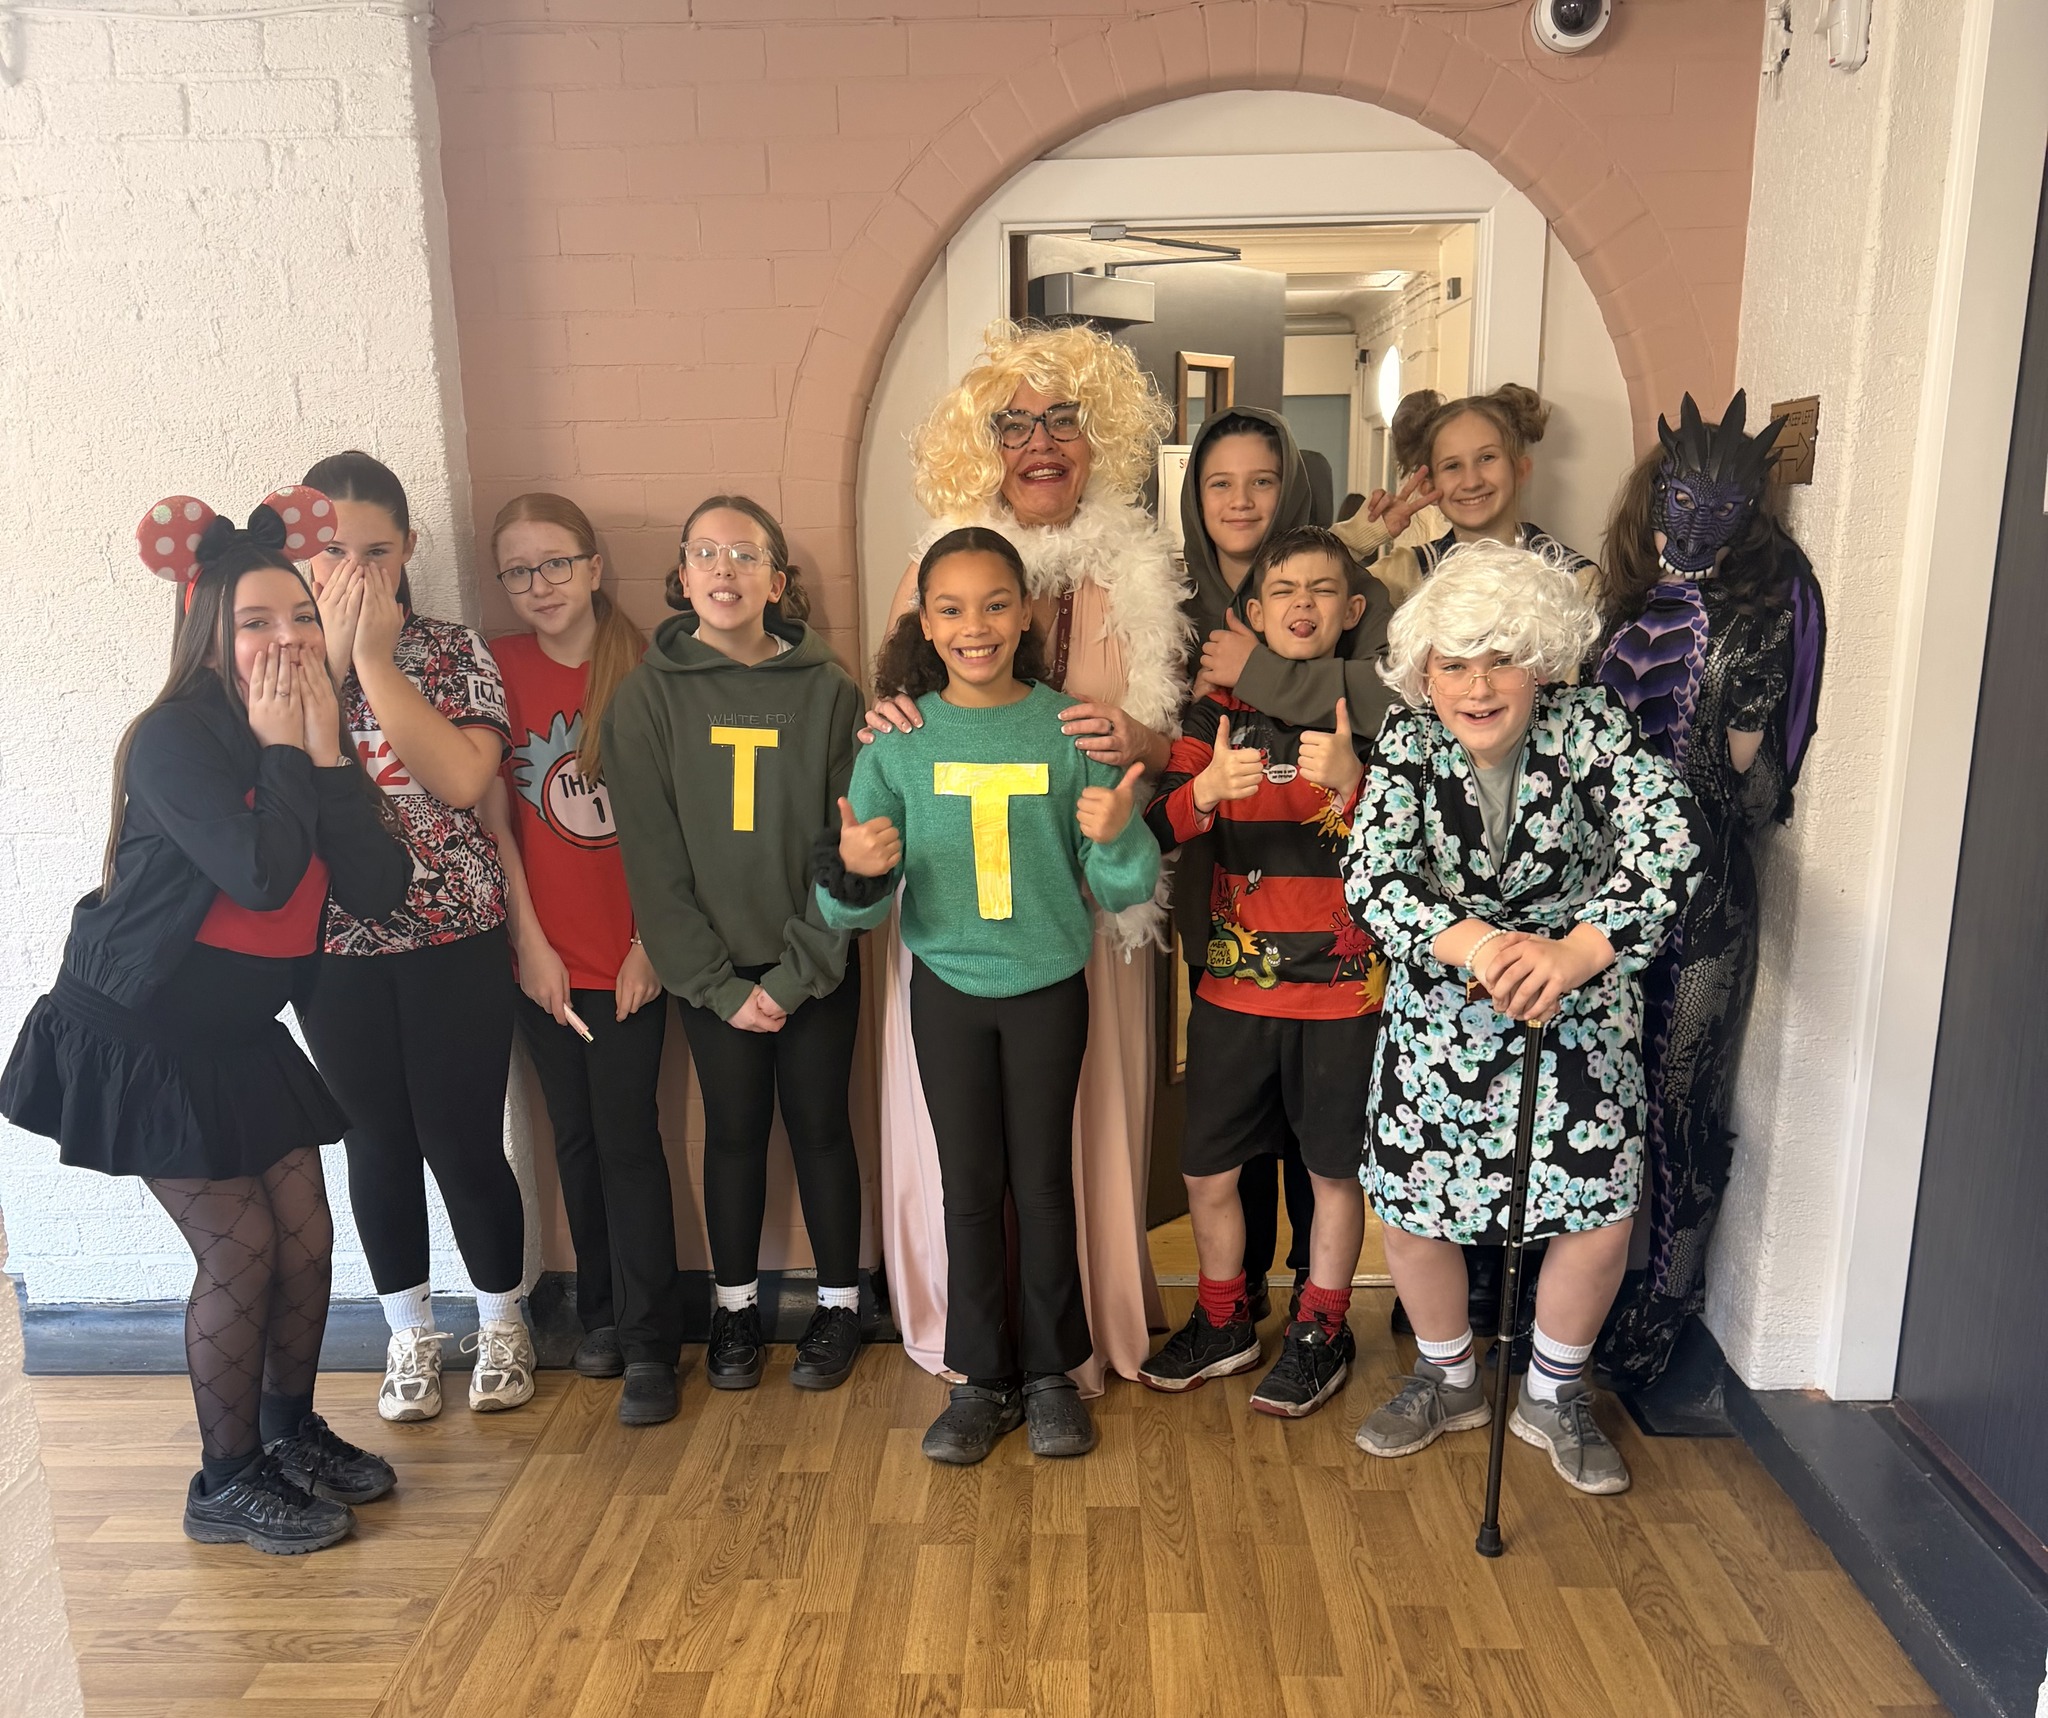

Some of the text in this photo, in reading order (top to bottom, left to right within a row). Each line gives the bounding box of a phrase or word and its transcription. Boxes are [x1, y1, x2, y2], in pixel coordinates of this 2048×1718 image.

[707, 713, 796, 725] WHITE FOX
[711, 726, 778, 831] T
[592, 796, 606, 823] 1
[934, 762, 1049, 920] T
[1209, 949, 1231, 957] TINK
